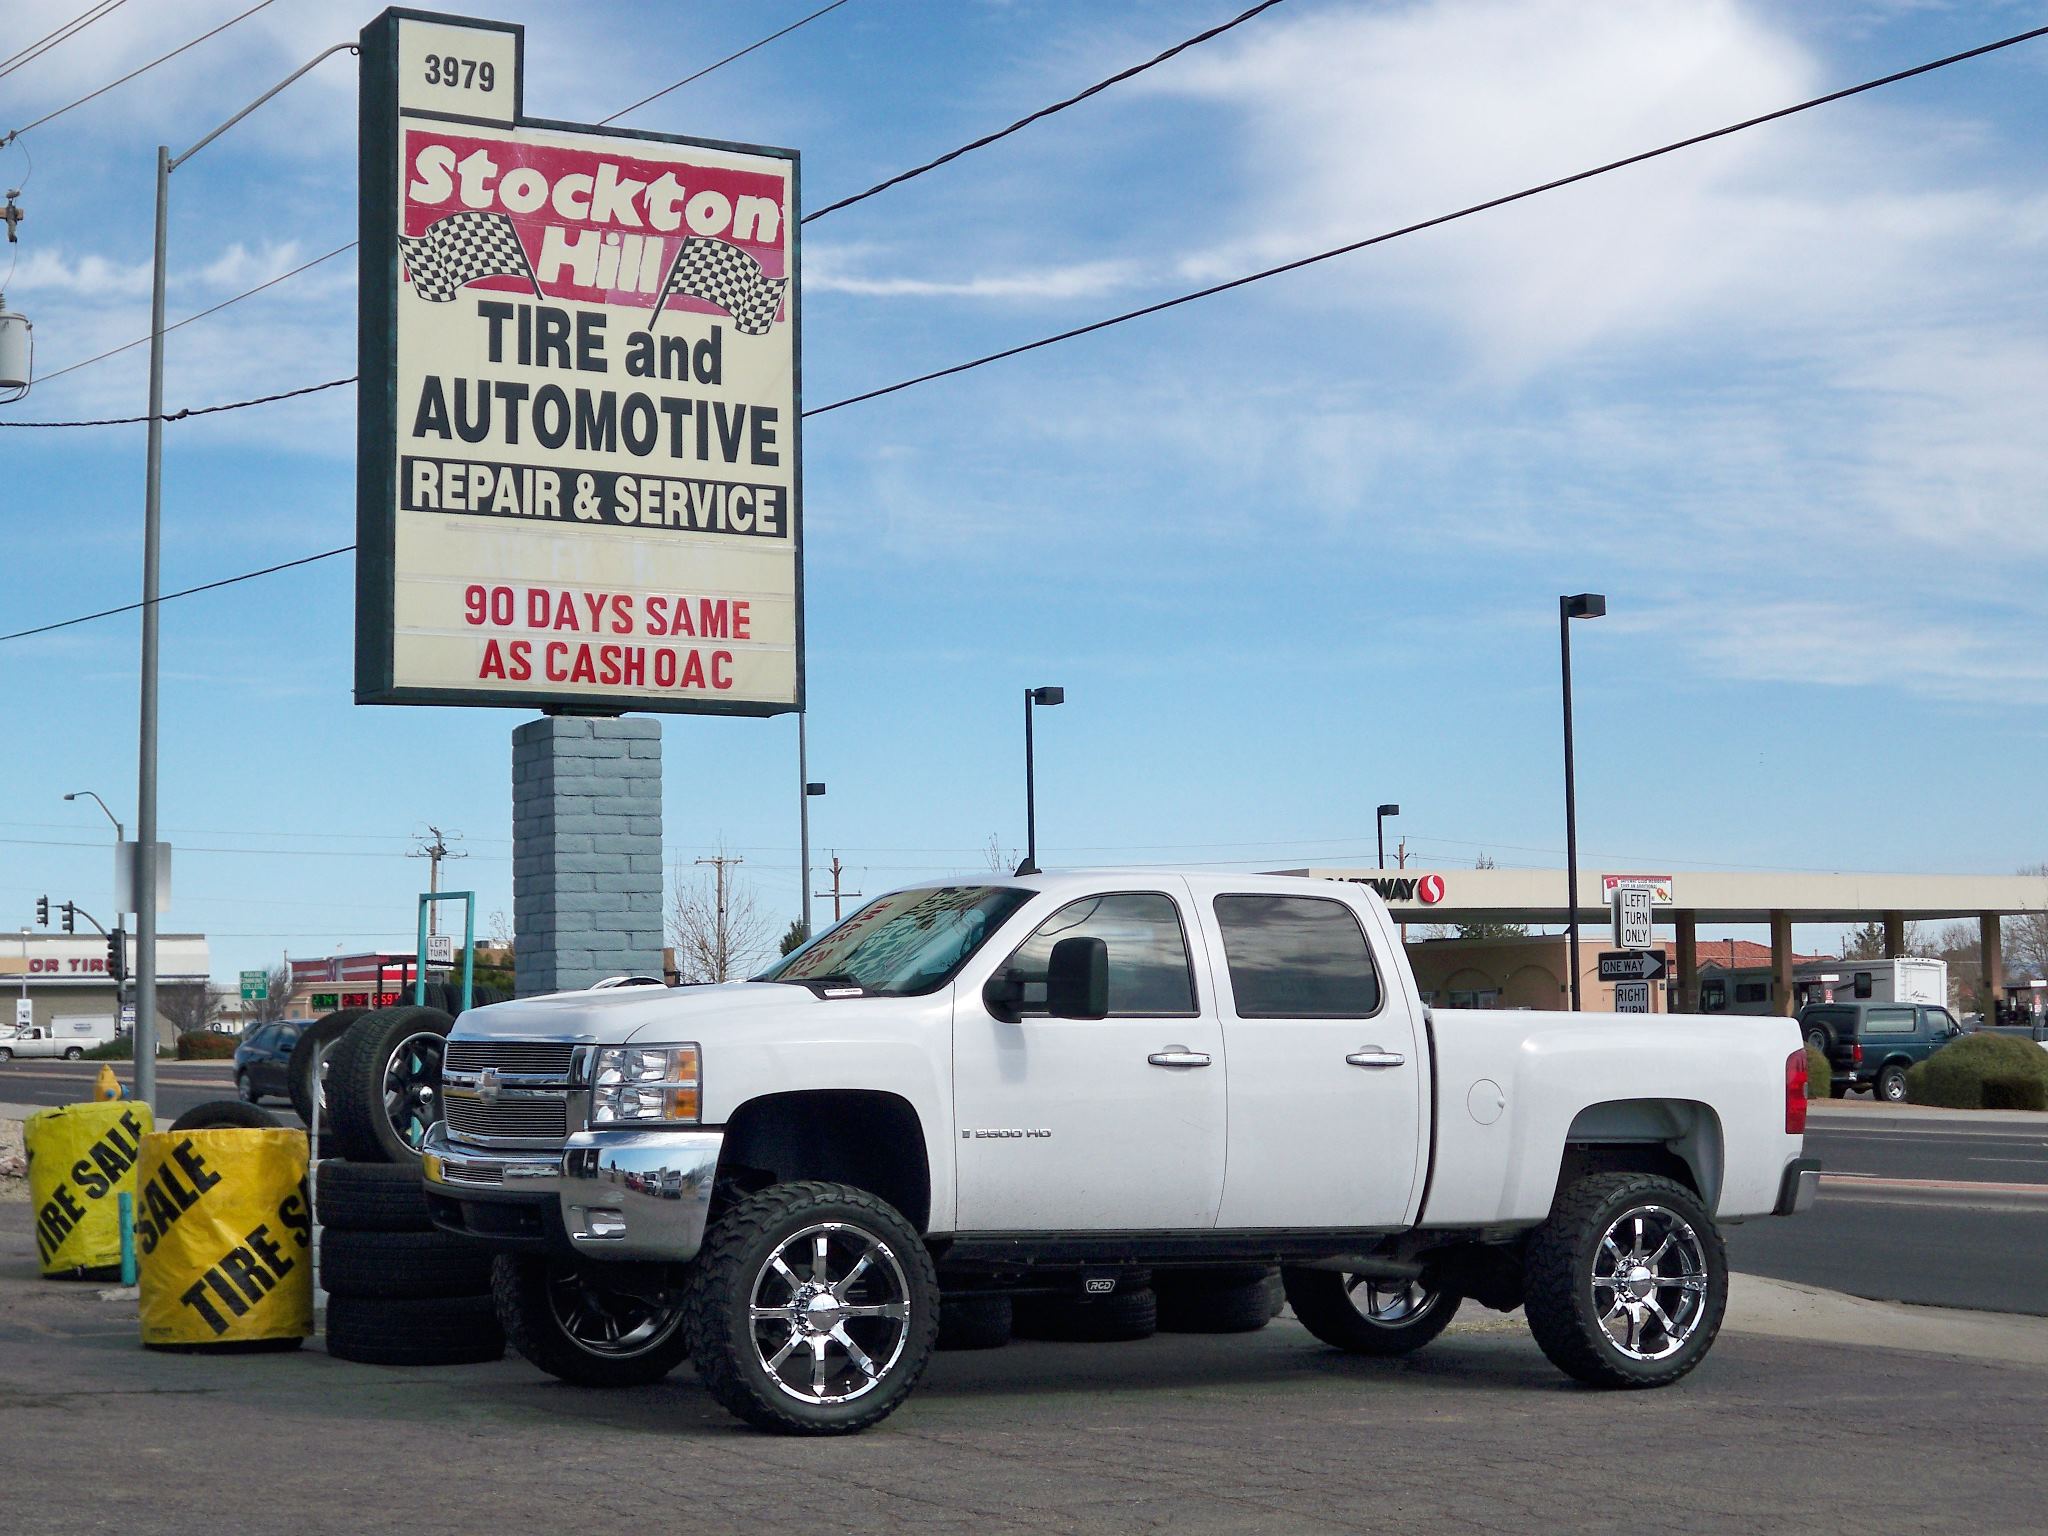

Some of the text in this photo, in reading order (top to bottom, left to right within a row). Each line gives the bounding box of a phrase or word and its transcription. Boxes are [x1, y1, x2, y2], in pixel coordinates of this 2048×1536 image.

[424, 54, 495, 92] 3979
[408, 145, 781, 244] Stockton
[537, 225, 664, 294] Hill
[478, 300, 722, 385] TIRE and
[412, 375, 779, 467] AUTOMOTIVE
[412, 460, 777, 533] REPAIR & SERVICE
[465, 585, 751, 639] 90 DAYS SAME
[479, 639, 733, 689] AS CASH OAC
[1625, 893, 1647, 907] LEFT
[1625, 911, 1648, 925] TURN
[430, 939, 447, 947] LEFT
[1625, 929, 1648, 942] ONLY
[1603, 960, 1644, 972] ONE WAY
[1617, 988, 1646, 1002] RIGHT
[71, 1109, 142, 1199] SALE
[976, 1128, 1052, 1138] 2500 HD
[135, 1138, 222, 1254] SALE
[180, 1223, 295, 1336] TIRE
